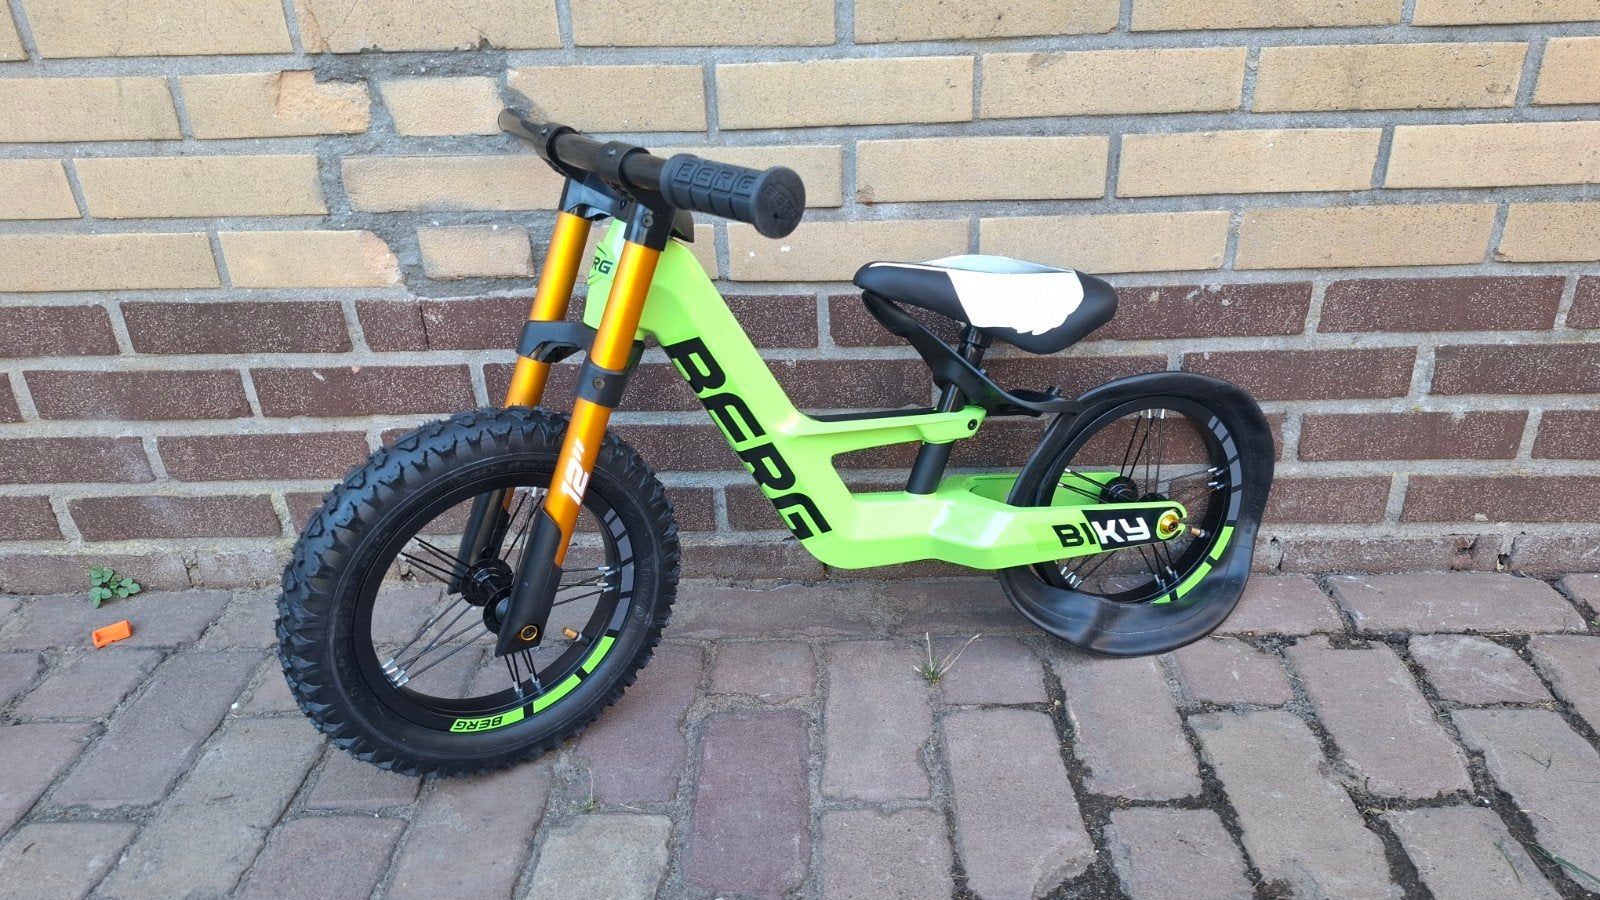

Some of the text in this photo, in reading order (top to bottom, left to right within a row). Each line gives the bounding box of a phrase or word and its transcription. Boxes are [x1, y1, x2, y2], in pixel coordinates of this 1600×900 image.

[676, 163, 757, 189] BERG
[665, 337, 832, 540] BERG
[1052, 517, 1151, 548] BIKY
[453, 715, 503, 730] BERG
